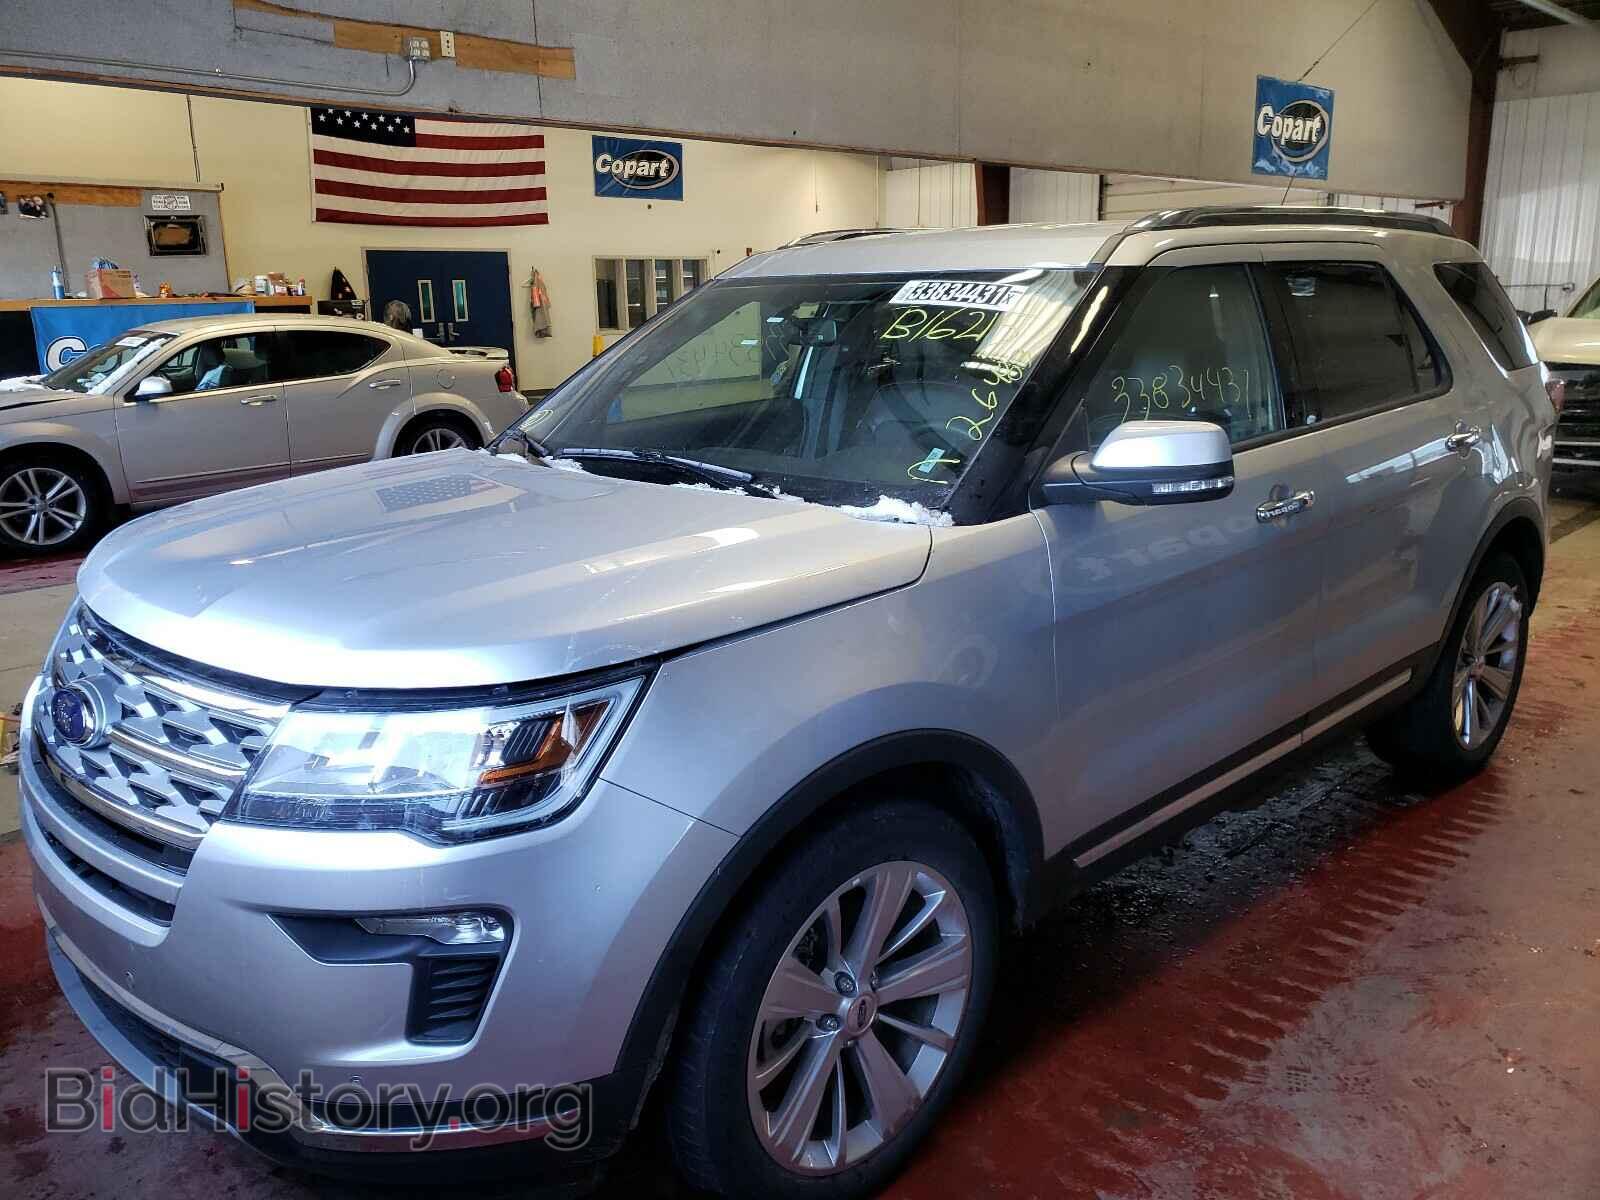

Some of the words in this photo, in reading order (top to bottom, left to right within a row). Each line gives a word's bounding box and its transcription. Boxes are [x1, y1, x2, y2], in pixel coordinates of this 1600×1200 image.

[1257, 105, 1321, 146] Copart
[595, 153, 669, 179] Copart
[910, 282, 1009, 305] 33834431
[880, 306, 999, 342] B1621
[1112, 365, 1251, 424] 33834431
